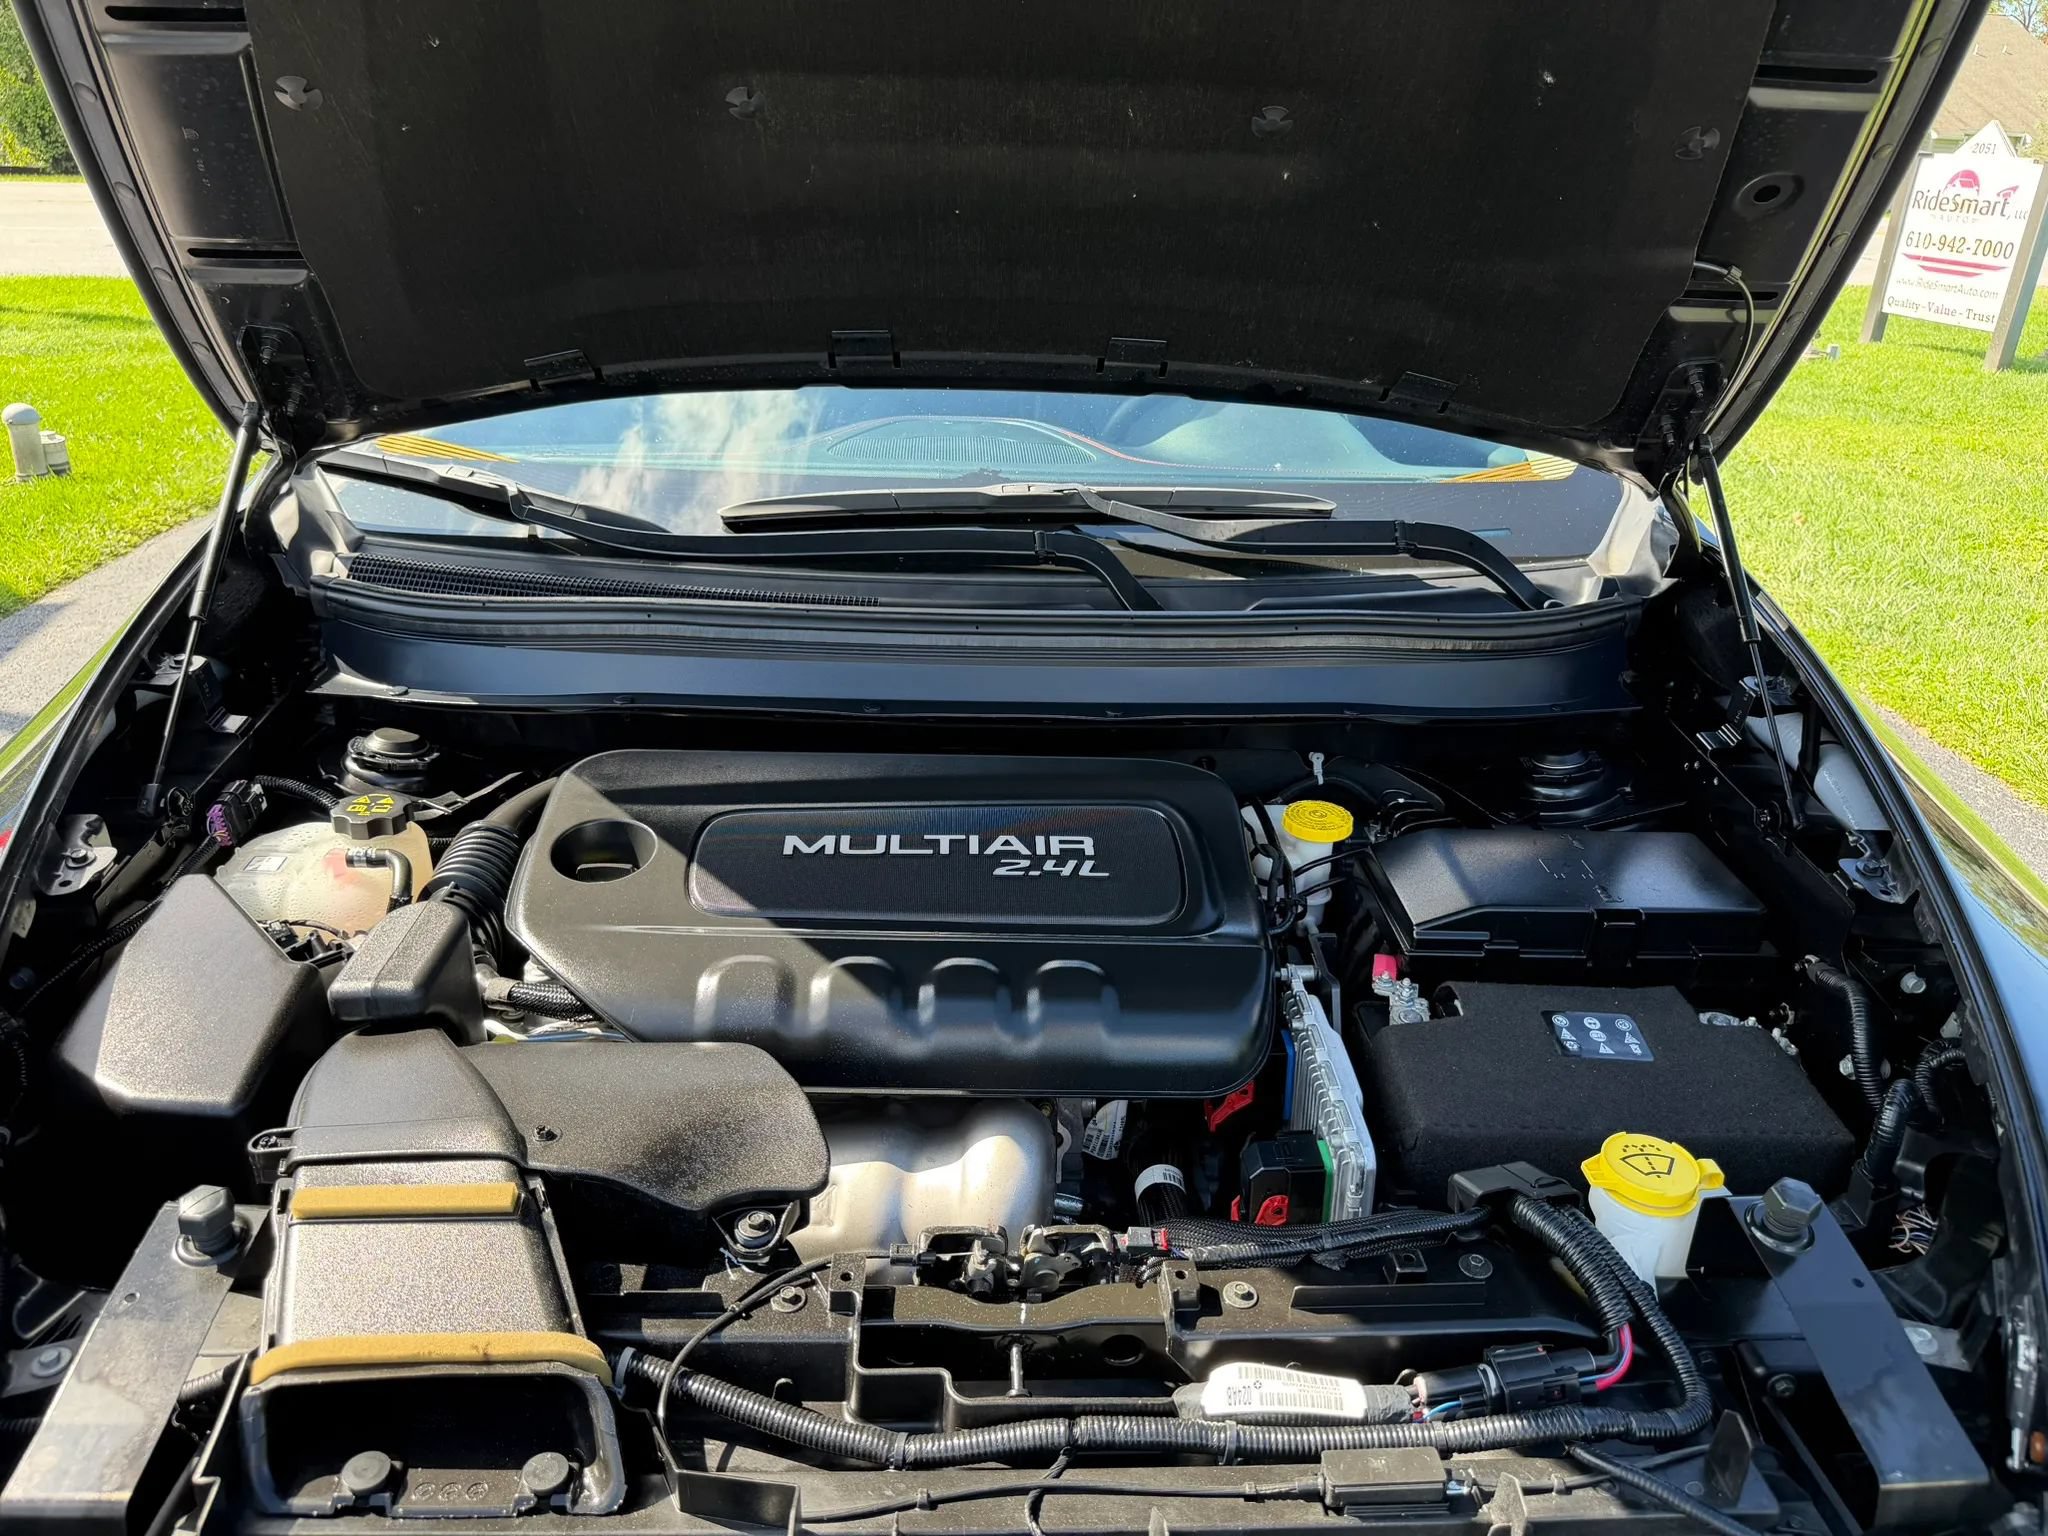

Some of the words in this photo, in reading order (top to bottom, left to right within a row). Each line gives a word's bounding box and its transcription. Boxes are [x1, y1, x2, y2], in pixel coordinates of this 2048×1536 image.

[1971, 142, 1998, 155] 2051
[1905, 230, 2015, 260] 610-942-7000
[782, 834, 1096, 856] MULTIAIR
[992, 859, 1110, 877] 2.4L
